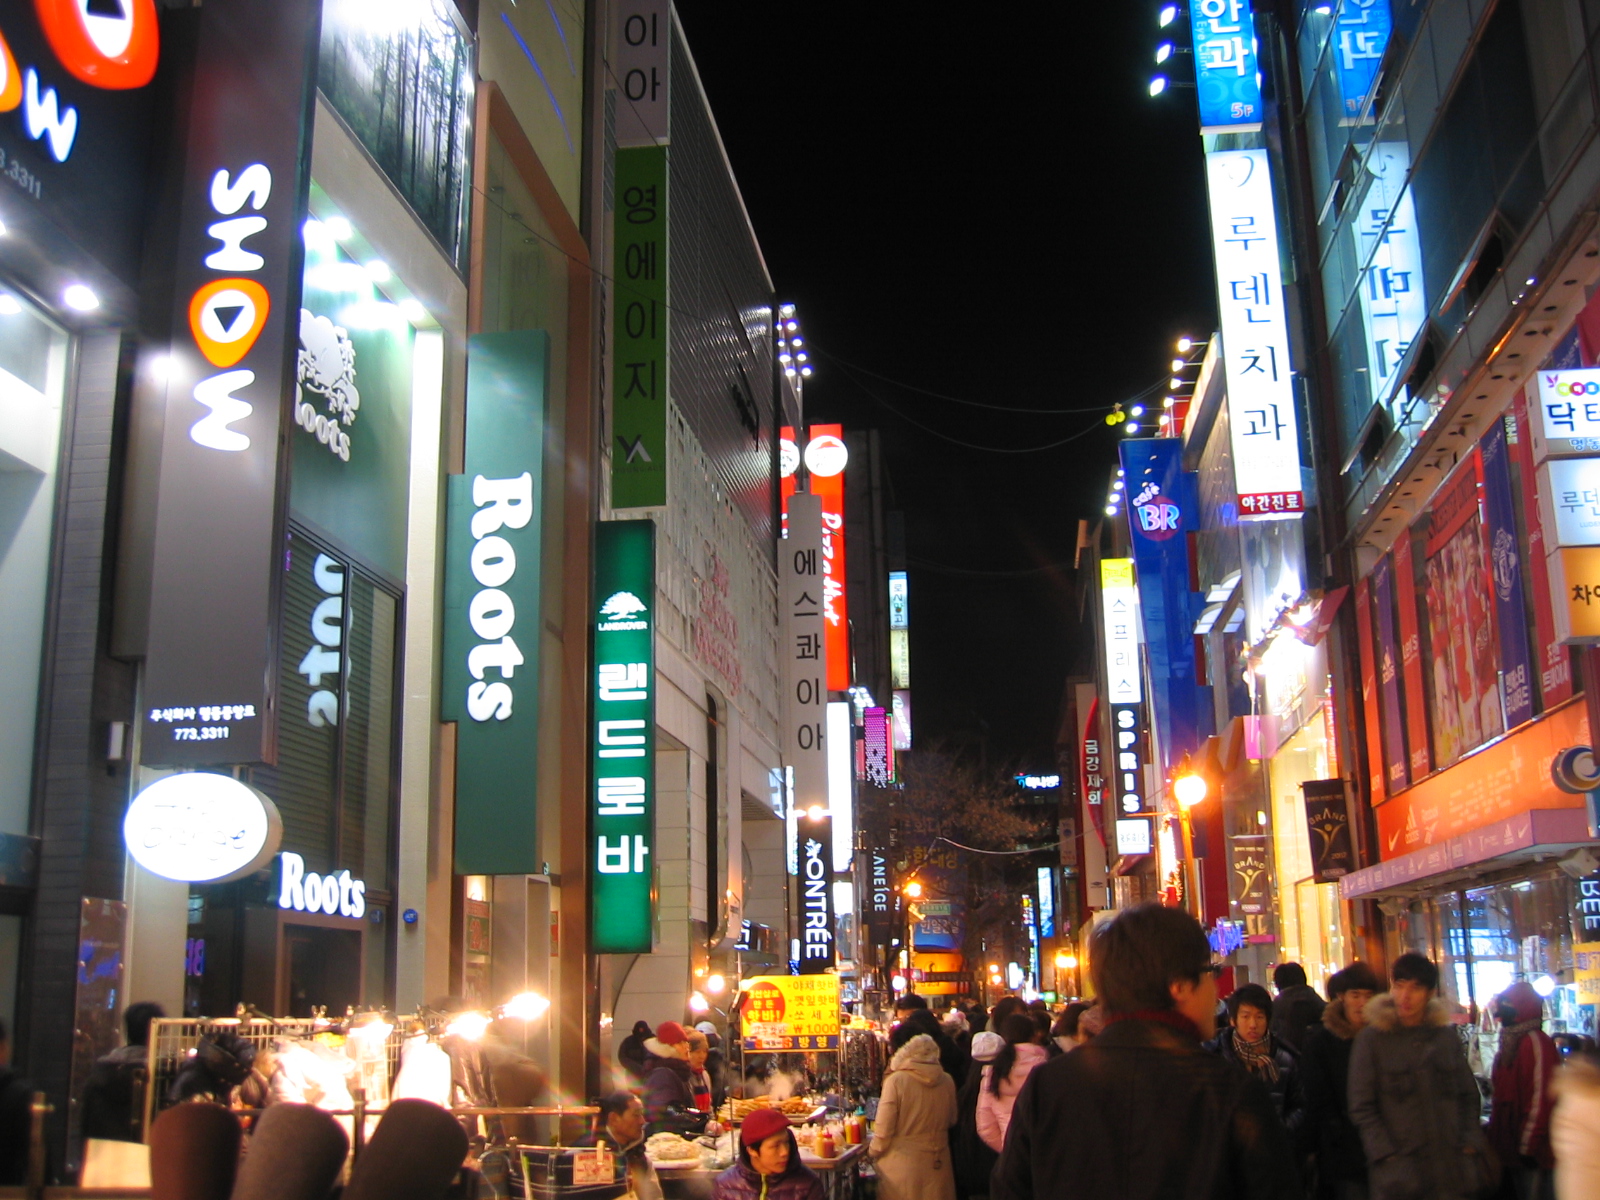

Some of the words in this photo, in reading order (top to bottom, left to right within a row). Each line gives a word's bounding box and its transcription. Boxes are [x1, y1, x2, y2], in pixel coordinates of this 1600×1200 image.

[624, 13, 661, 102] 이아
[1201, 0, 1250, 76] 안과
[1230, 102, 1254, 118] 5F
[187, 163, 272, 452] SHOW
[622, 184, 657, 400] 영에이지
[1224, 216, 1287, 440] 루덴치과
[1137, 503, 1180, 531] BR
[1241, 494, 1300, 513] 야간진료
[466, 472, 533, 722] Roots
[598, 620, 648, 631] LANDROVER
[793, 548, 824, 751] 에스콰이아
[1111, 598, 1132, 694] 스프리스
[174, 726, 229, 741] 773.3311
[598, 662, 650, 874] 랜드로바
[1117, 709, 1141, 814] SPRIS
[1085, 739, 1101, 805] 금강제화
[1308, 807, 1347, 826] BRAND
[278, 851, 366, 918] Roots
[1234, 855, 1265, 870] BRAND
